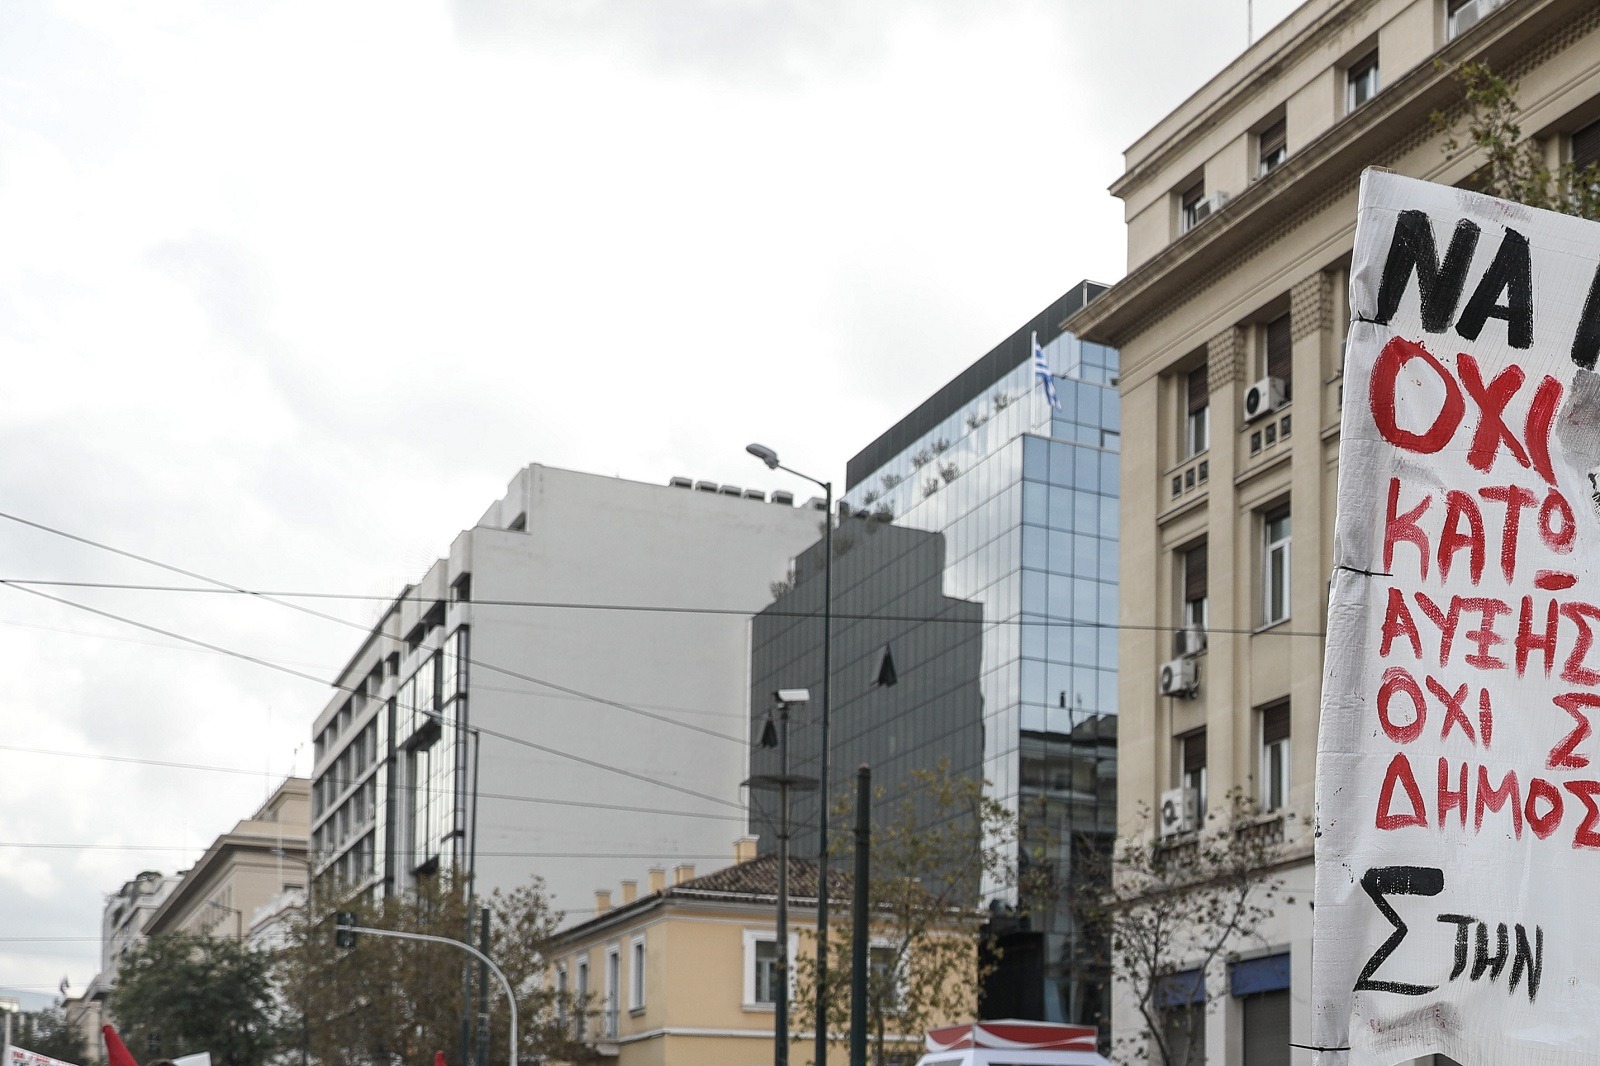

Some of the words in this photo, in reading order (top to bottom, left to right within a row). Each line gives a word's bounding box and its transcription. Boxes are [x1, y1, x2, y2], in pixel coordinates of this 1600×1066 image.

[1375, 209, 1535, 350] ΝΑ
[1369, 336, 1564, 486] ΟΧΙ
[1377, 666, 1492, 749] ΟΧΙ
